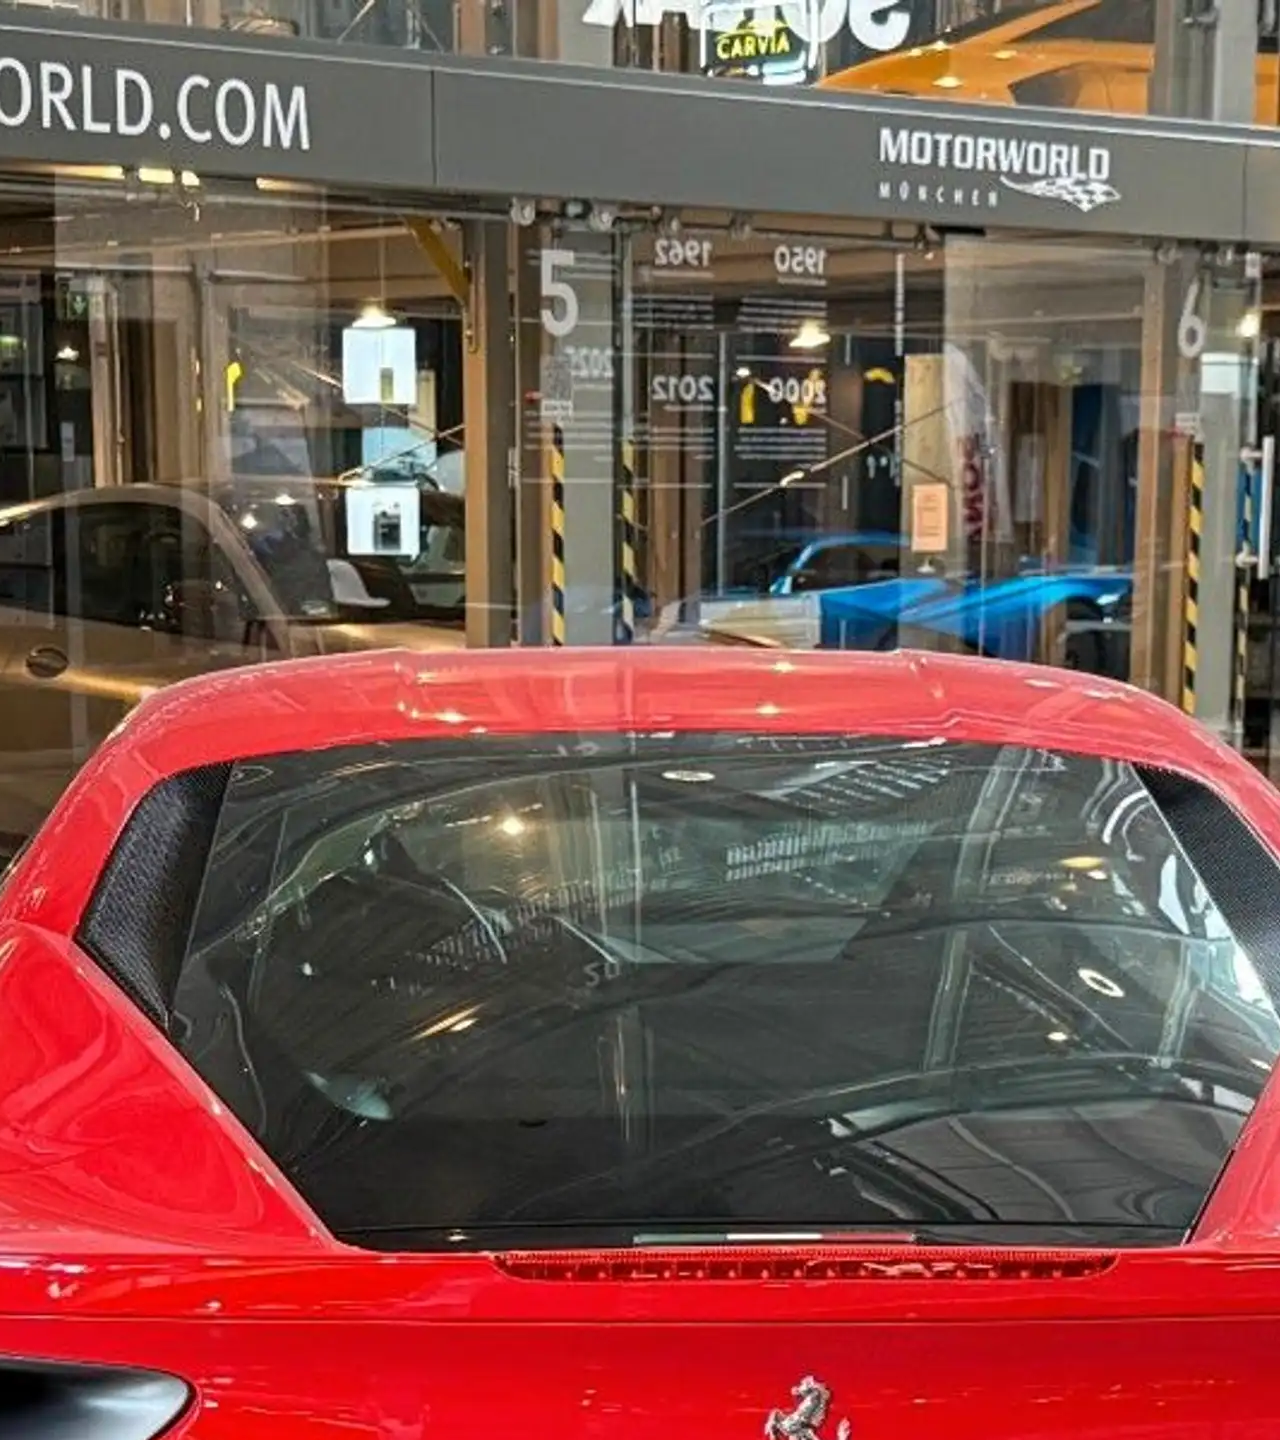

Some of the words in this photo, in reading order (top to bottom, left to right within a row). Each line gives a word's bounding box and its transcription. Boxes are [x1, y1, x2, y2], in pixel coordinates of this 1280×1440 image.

[716, 31, 792, 60] CARVIA
[878, 126, 1111, 182] MOTORWORLD
[539, 248, 579, 338] 5
[1177, 276, 1206, 359] 6
